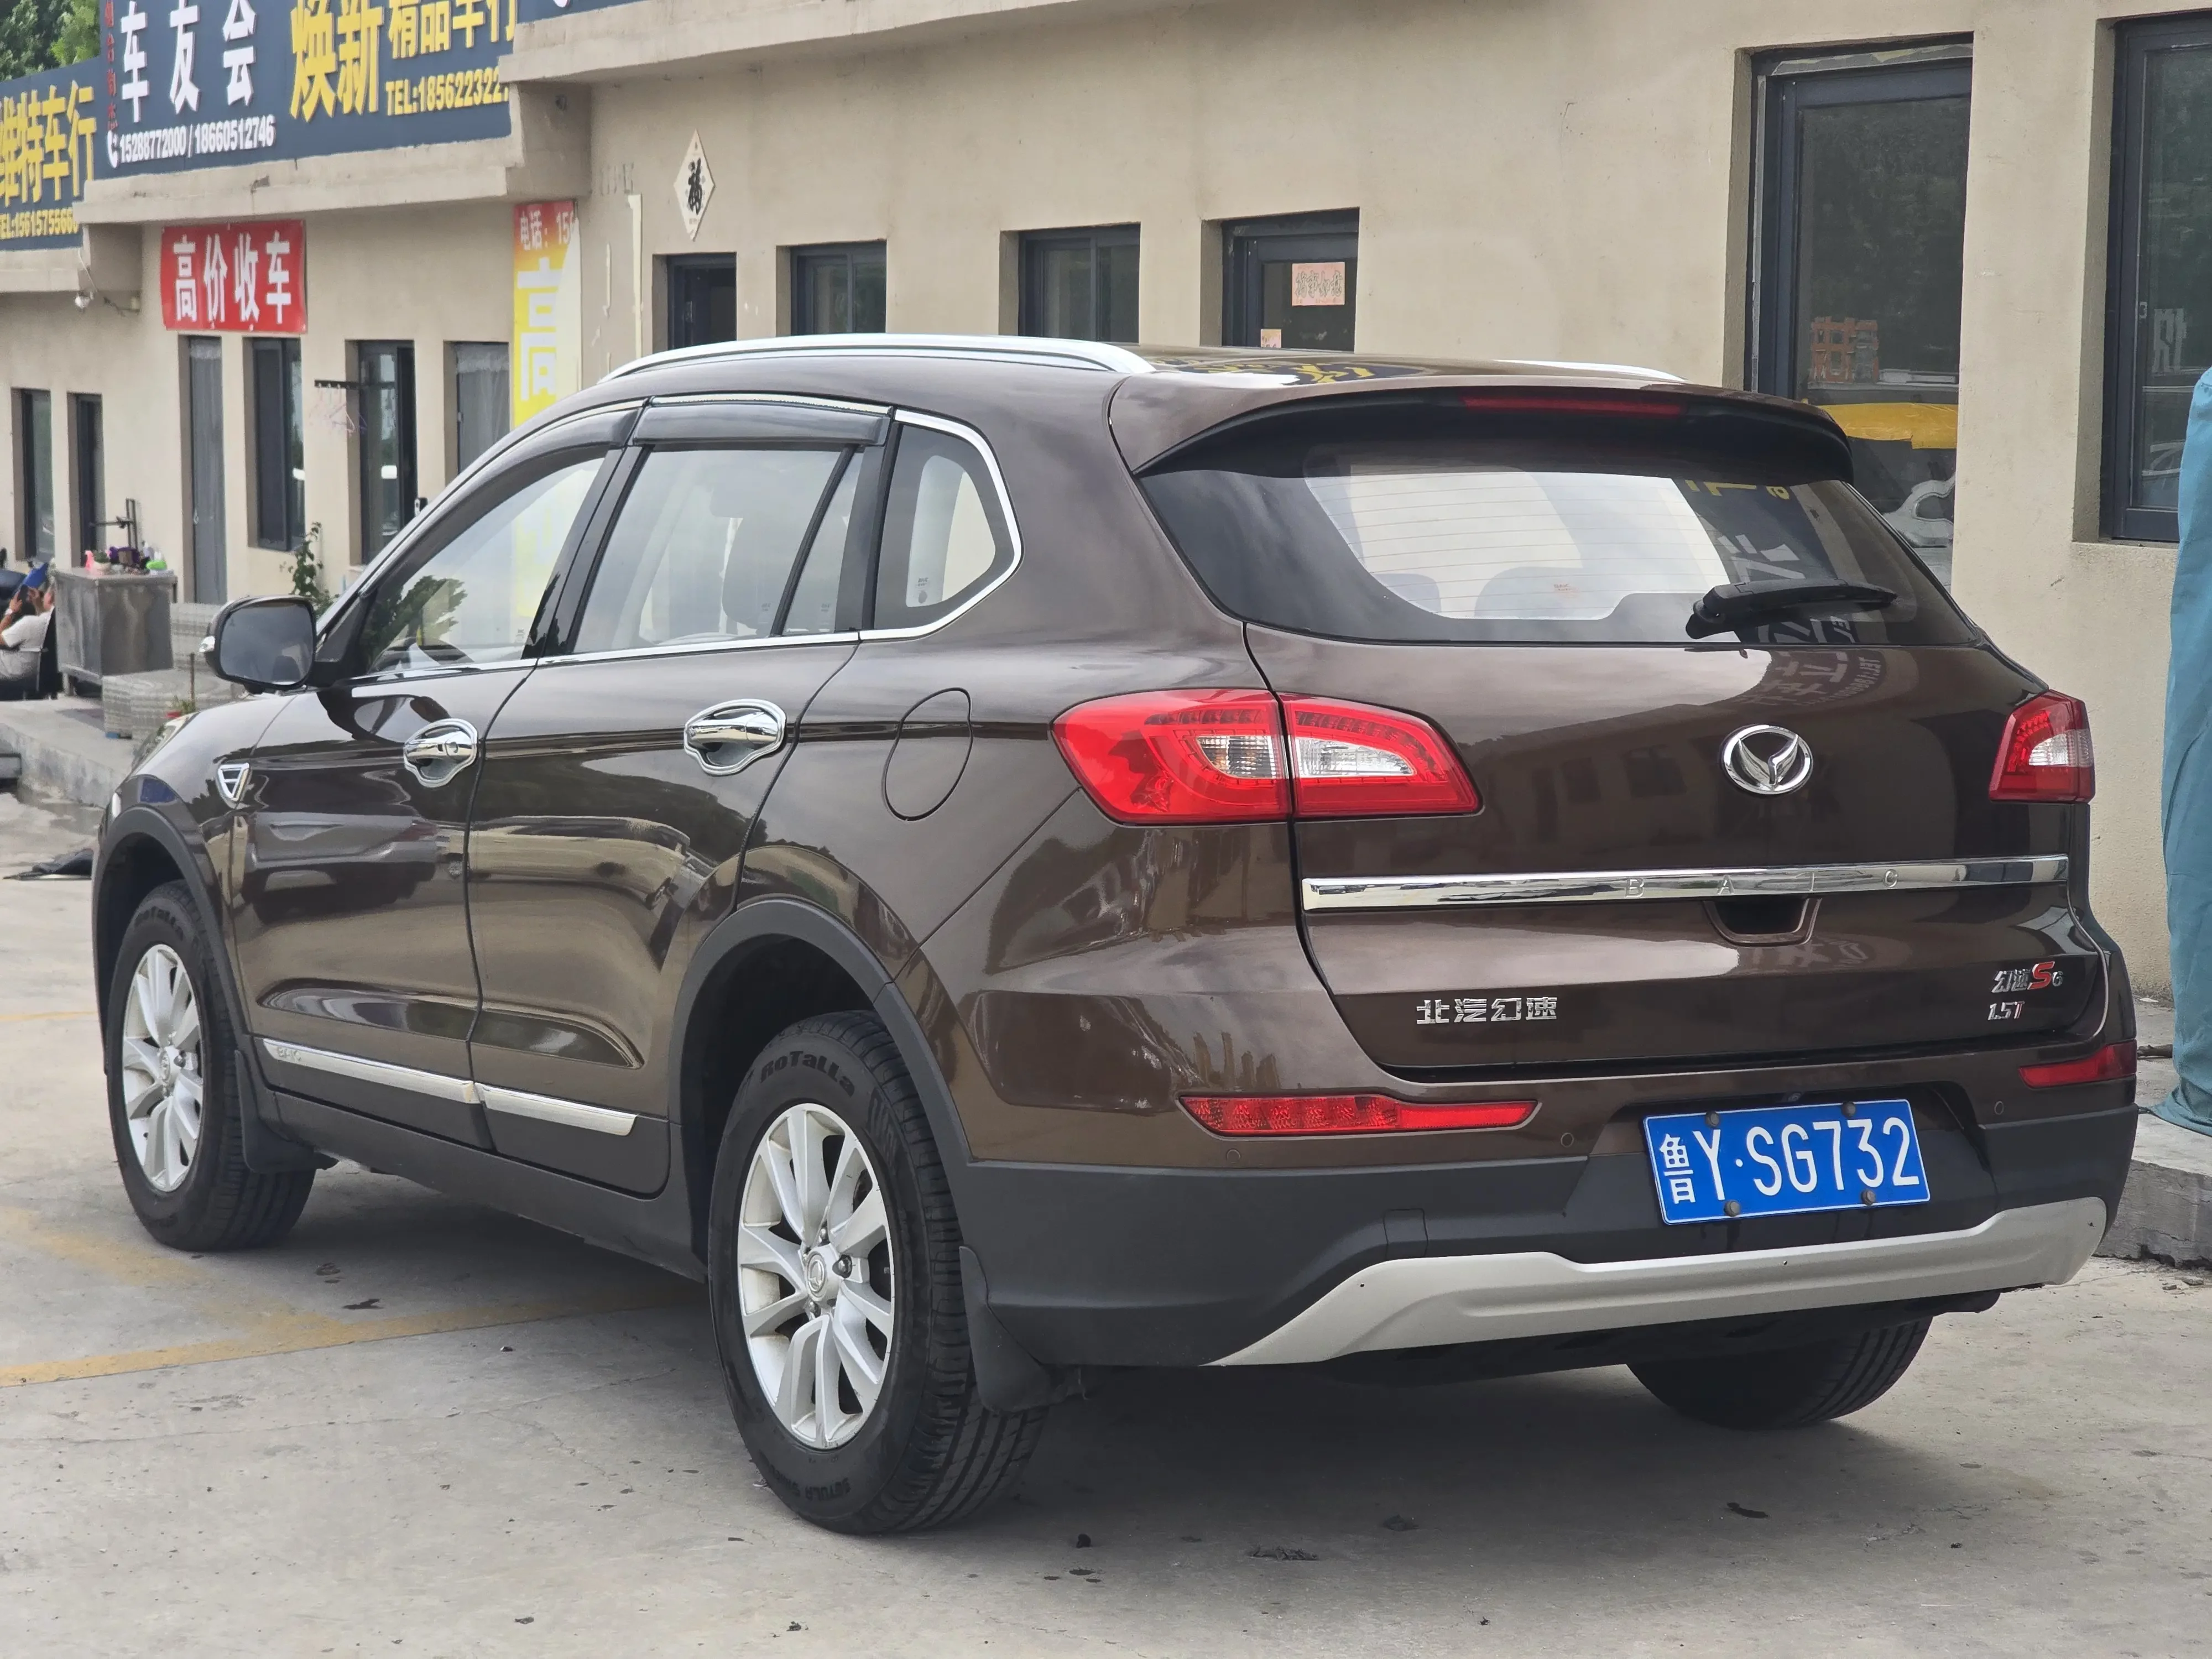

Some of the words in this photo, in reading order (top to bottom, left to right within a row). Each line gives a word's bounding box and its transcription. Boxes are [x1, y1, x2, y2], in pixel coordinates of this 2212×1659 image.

[121, 0, 258, 123] 车友会
[290, 0, 384, 122] 焕新
[386, 66, 508, 116] TEL:185622322
[173, 230, 292, 324] 高价收车
[1416, 997, 1558, 1024] 北汽幻速
